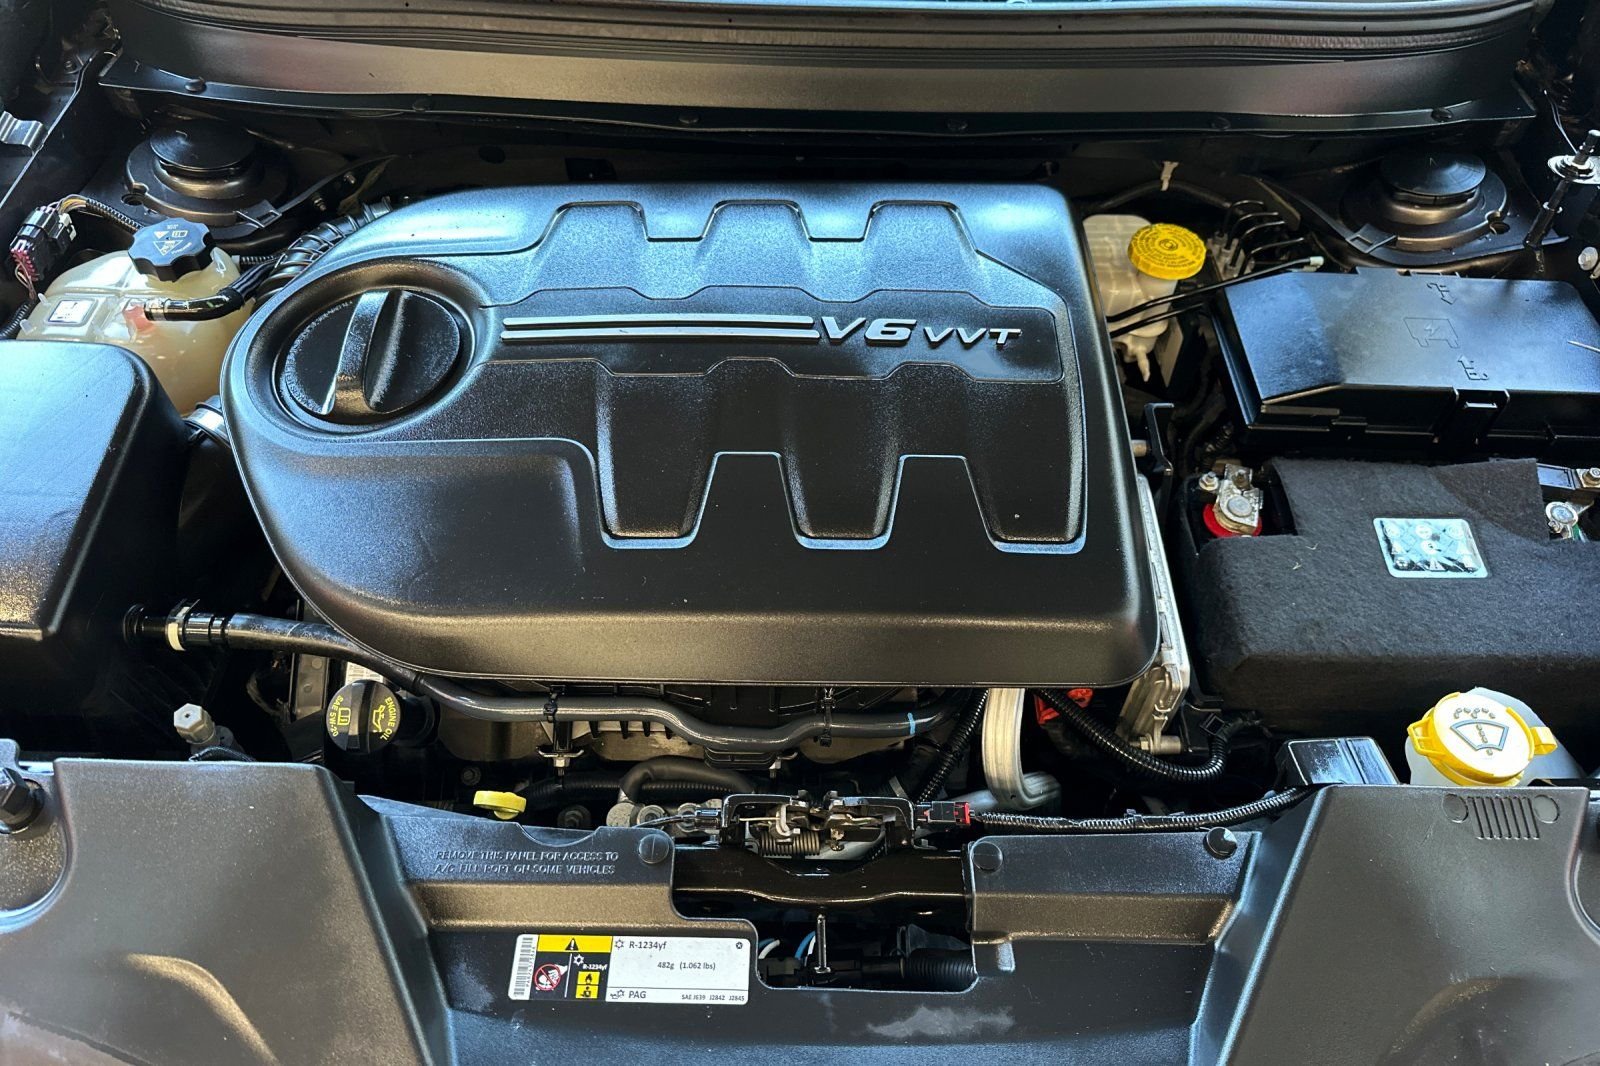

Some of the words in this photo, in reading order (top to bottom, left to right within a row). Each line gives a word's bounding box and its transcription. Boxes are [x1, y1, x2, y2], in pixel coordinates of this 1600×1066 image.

[821, 316, 917, 346] V6
[923, 327, 1022, 348] VVT
[331, 695, 344, 711] SAE
[385, 696, 397, 728] ENGINE
[329, 712, 339, 737] 5W-20
[380, 728, 393, 741] OIL
[480, 850, 503, 860] THIS
[505, 851, 539, 861] PANEL
[540, 851, 561, 861] FOR
[562, 851, 604, 861] ACCESS
[605, 851, 619, 861] TO
[514, 864, 531, 874] ON
[532, 864, 562, 874] SOME
[566, 864, 616, 875] VEHICLES
[629, 940, 667, 951] R-1234yf
[582, 963, 608, 971] R-1234yf
[657, 961, 675, 970] 482g
[679, 962, 701, 970] (1.062
[703, 962, 716, 970] lbs)
[628, 990, 647, 999] PAG
